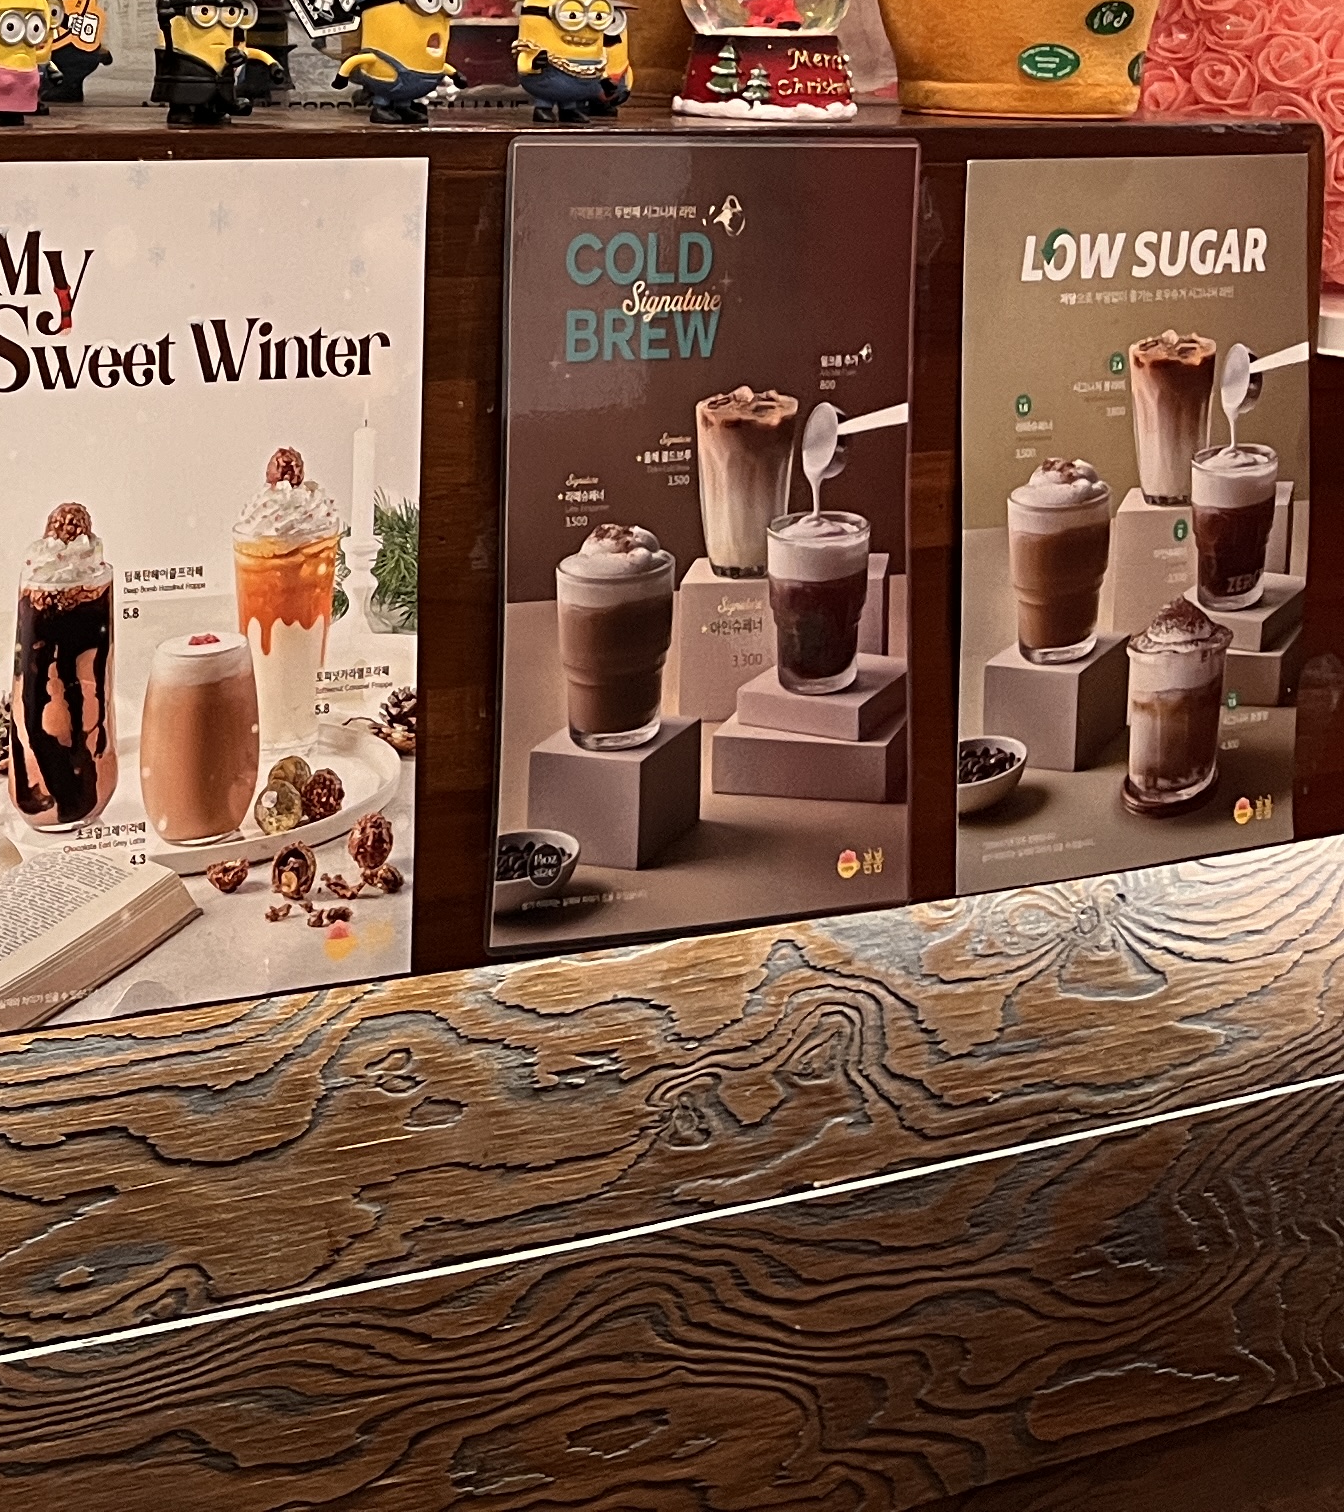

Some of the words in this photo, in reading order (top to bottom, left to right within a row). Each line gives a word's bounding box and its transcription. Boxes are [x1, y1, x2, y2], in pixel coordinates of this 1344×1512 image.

[565, 231, 713, 286] COLD
[1021, 232, 1126, 281] LOW
[1131, 227, 1268, 277] SUGAR
[622, 280, 722, 321] Signature
[188, 316, 391, 384] Winter
[566, 309, 721, 362] BREW
[123, 608, 139, 619] 5.8
[315, 703, 330, 715] 5.8
[130, 854, 146, 865] 4.3
